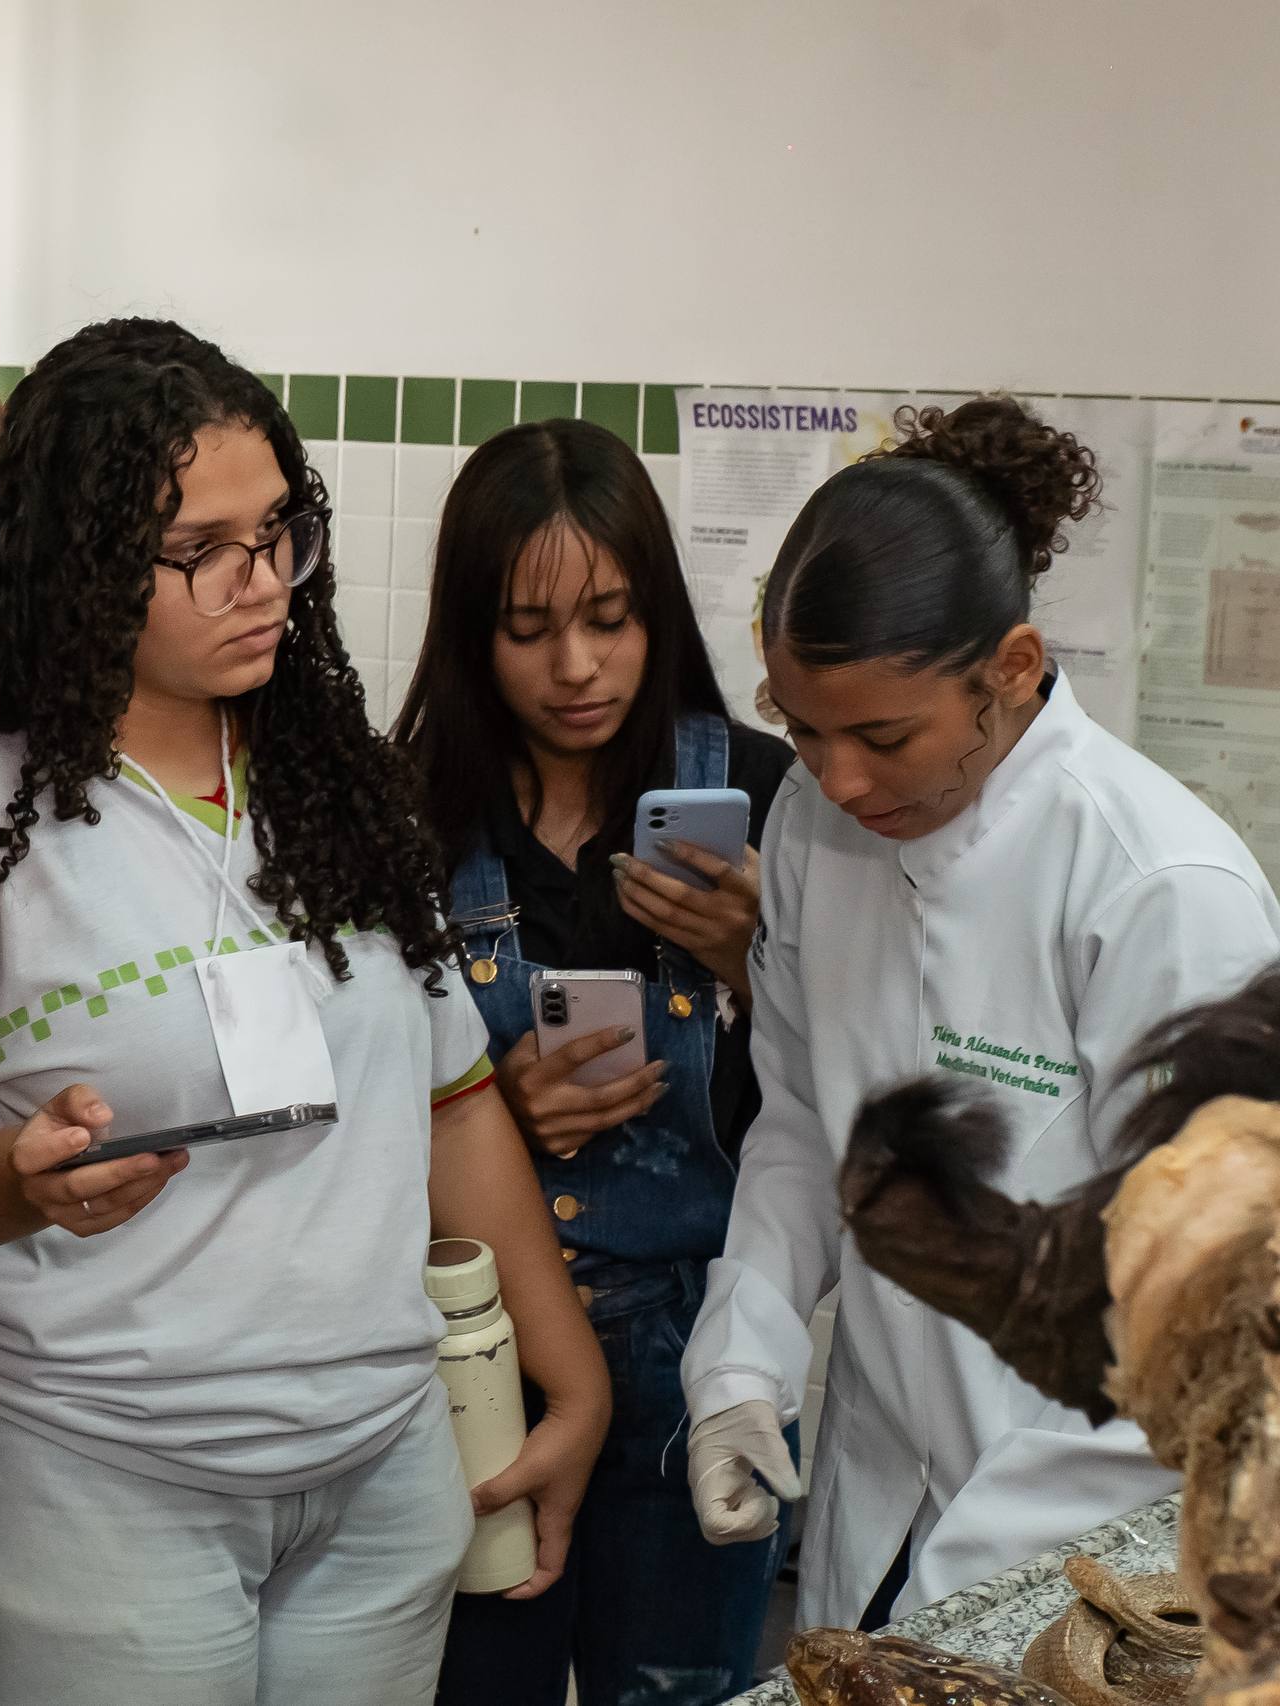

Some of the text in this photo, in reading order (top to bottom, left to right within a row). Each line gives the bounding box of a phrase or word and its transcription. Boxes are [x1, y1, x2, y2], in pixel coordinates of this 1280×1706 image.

[692, 403, 858, 433] ECOSSISTEMAS
[964, 1036, 1031, 1065] Alessandra
[935, 1051, 1061, 1098] Medicina Veterinária
